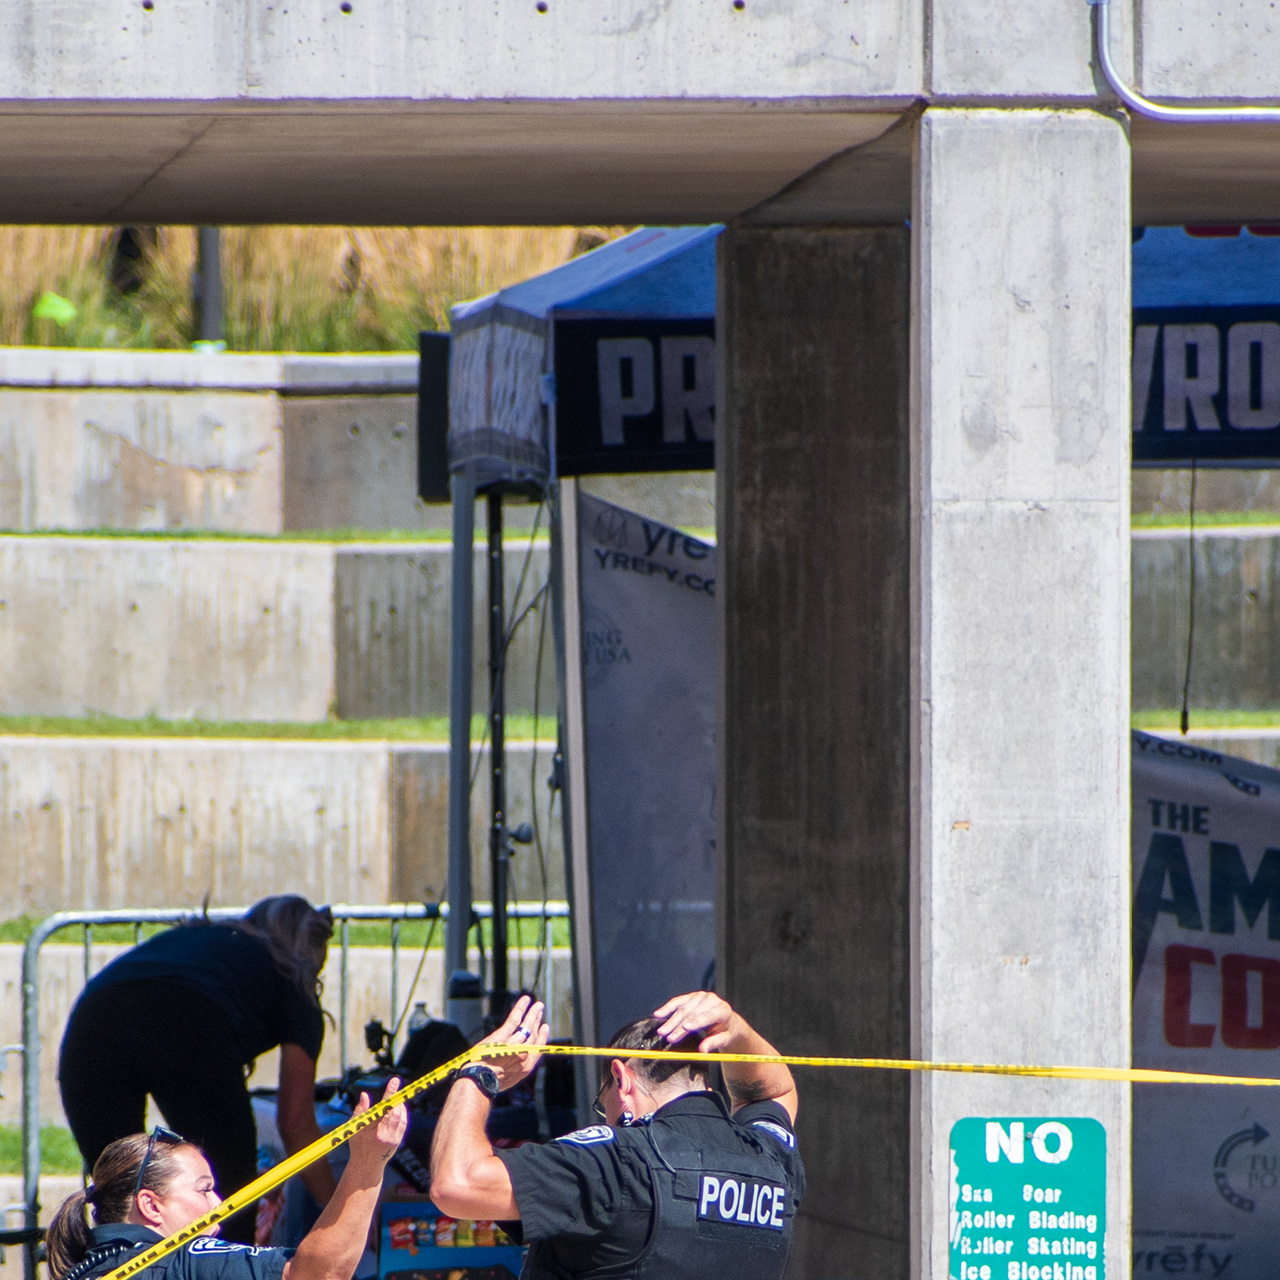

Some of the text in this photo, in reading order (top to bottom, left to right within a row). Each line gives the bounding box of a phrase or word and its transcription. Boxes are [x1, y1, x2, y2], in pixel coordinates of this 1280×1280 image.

[1147, 798, 1210, 836] THE
[985, 1121, 1073, 1164] NO
[700, 1176, 785, 1228] POLICE
[960, 1210, 1097, 1233] Roller Blading
[1027, 1236, 1097, 1260] Skating
[960, 1261, 991, 1280] Ice
